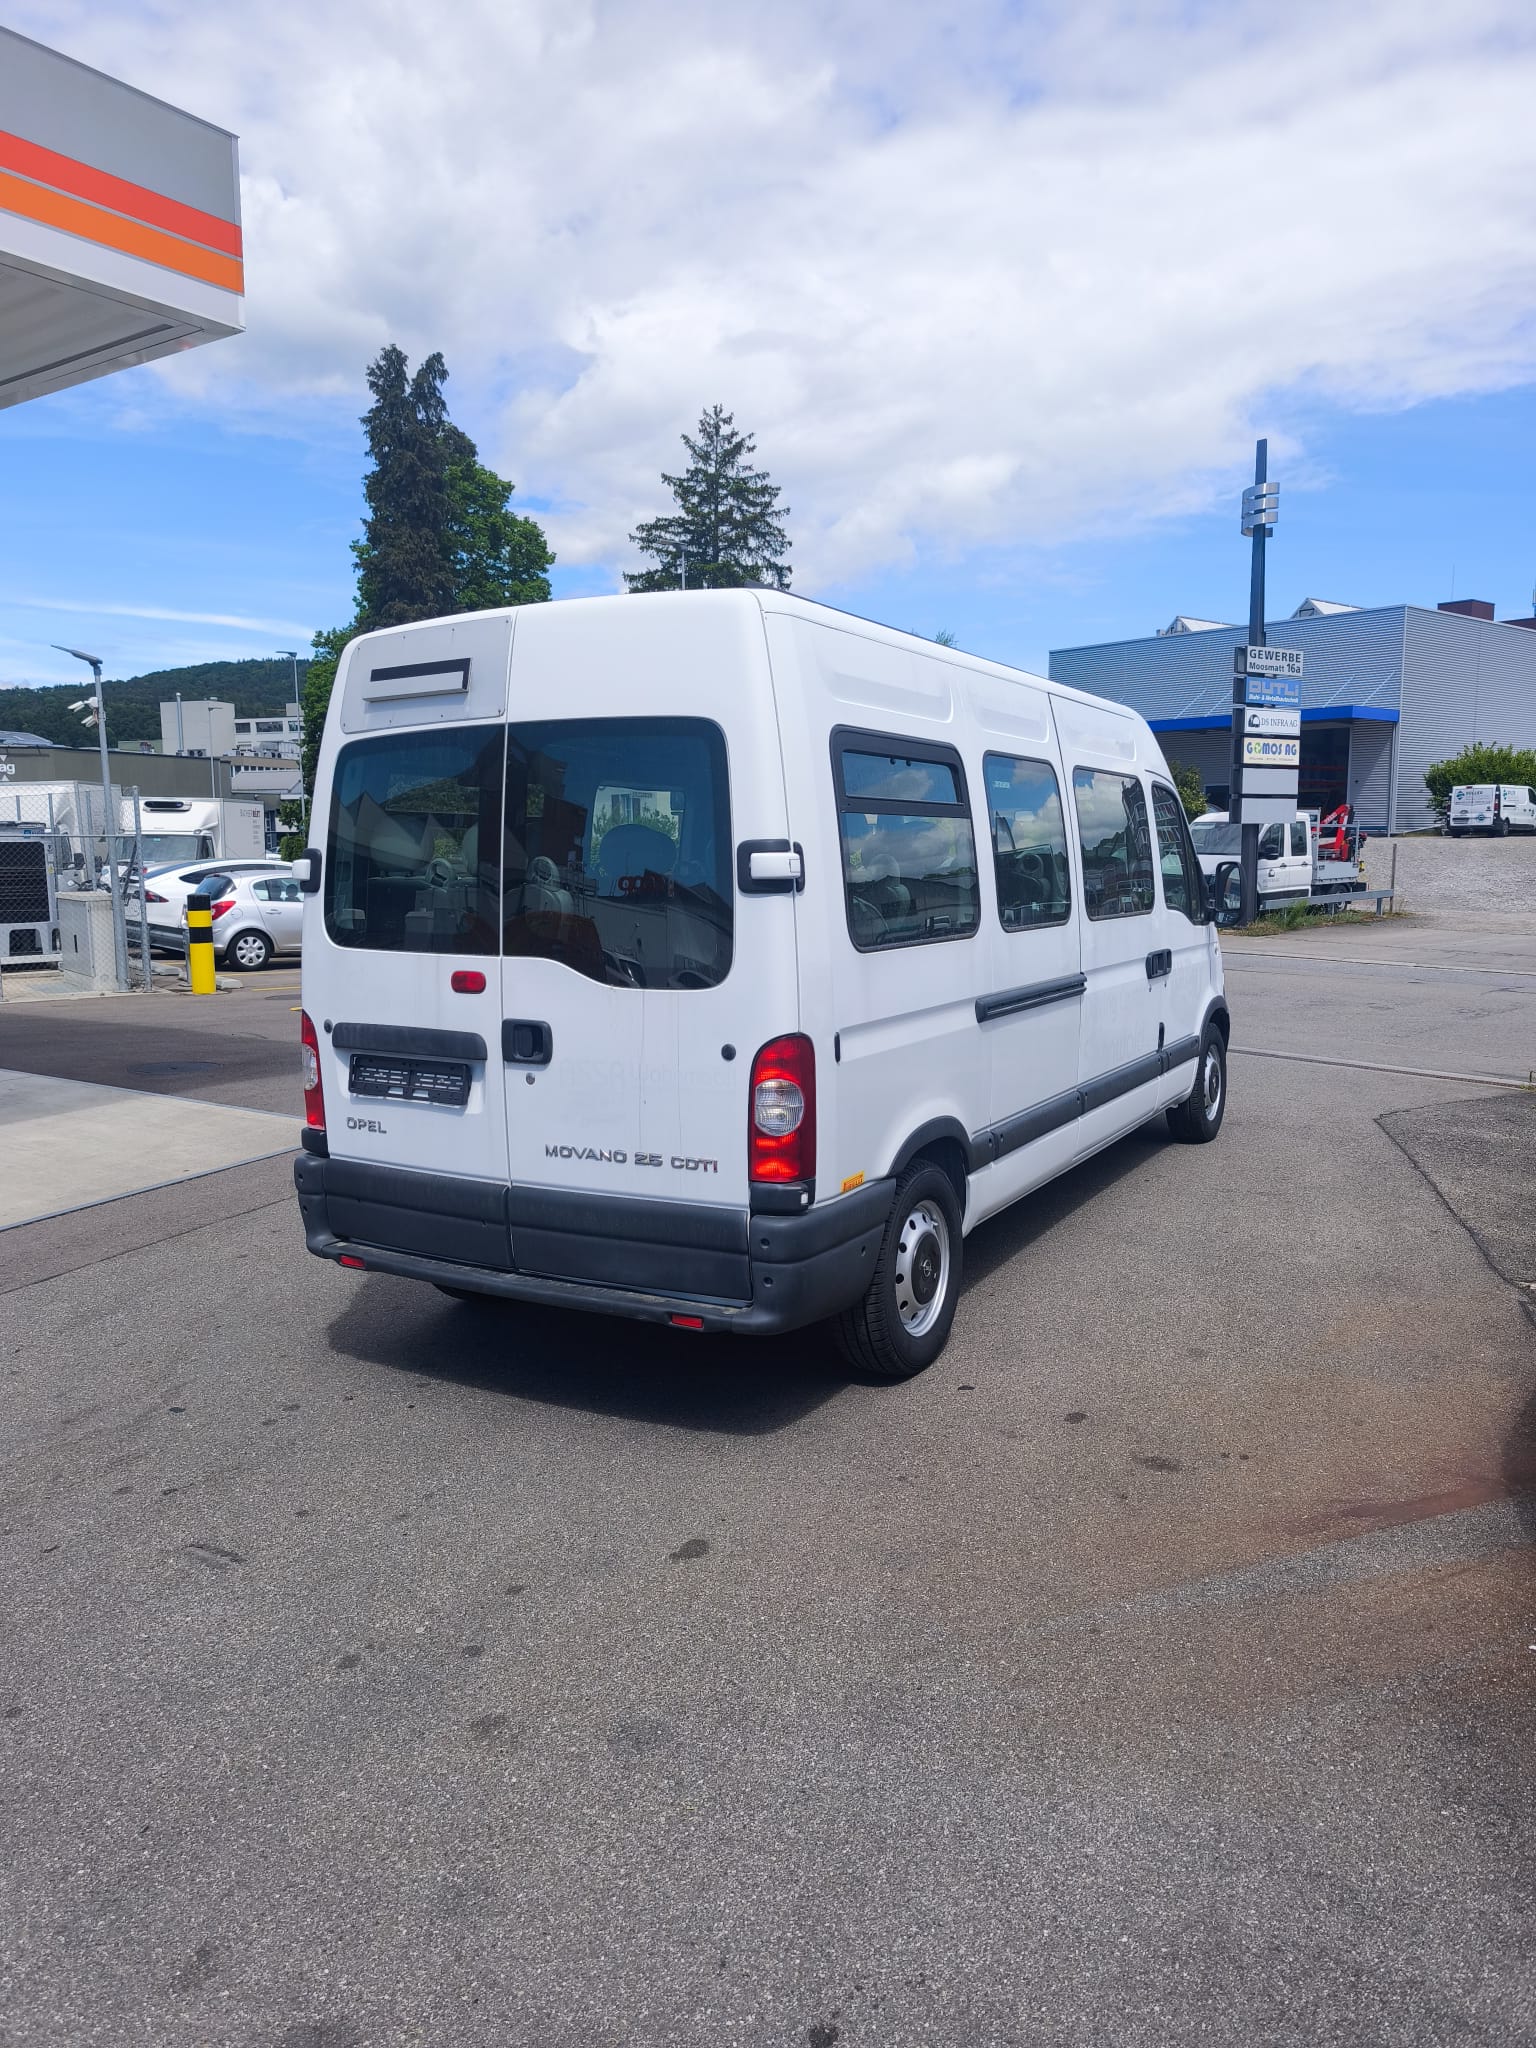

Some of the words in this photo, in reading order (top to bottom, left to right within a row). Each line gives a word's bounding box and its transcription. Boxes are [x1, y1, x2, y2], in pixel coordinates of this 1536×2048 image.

[1249, 649, 1302, 663] GEWERBE
[1249, 662, 1285, 673] Moosmatt
[1286, 663, 1301, 674] 16a
[1270, 718, 1289, 728] INFRA
[1284, 743, 1297, 756] AG
[346, 1116, 388, 1134] OPEL
[545, 1144, 628, 1164] MOVANO
